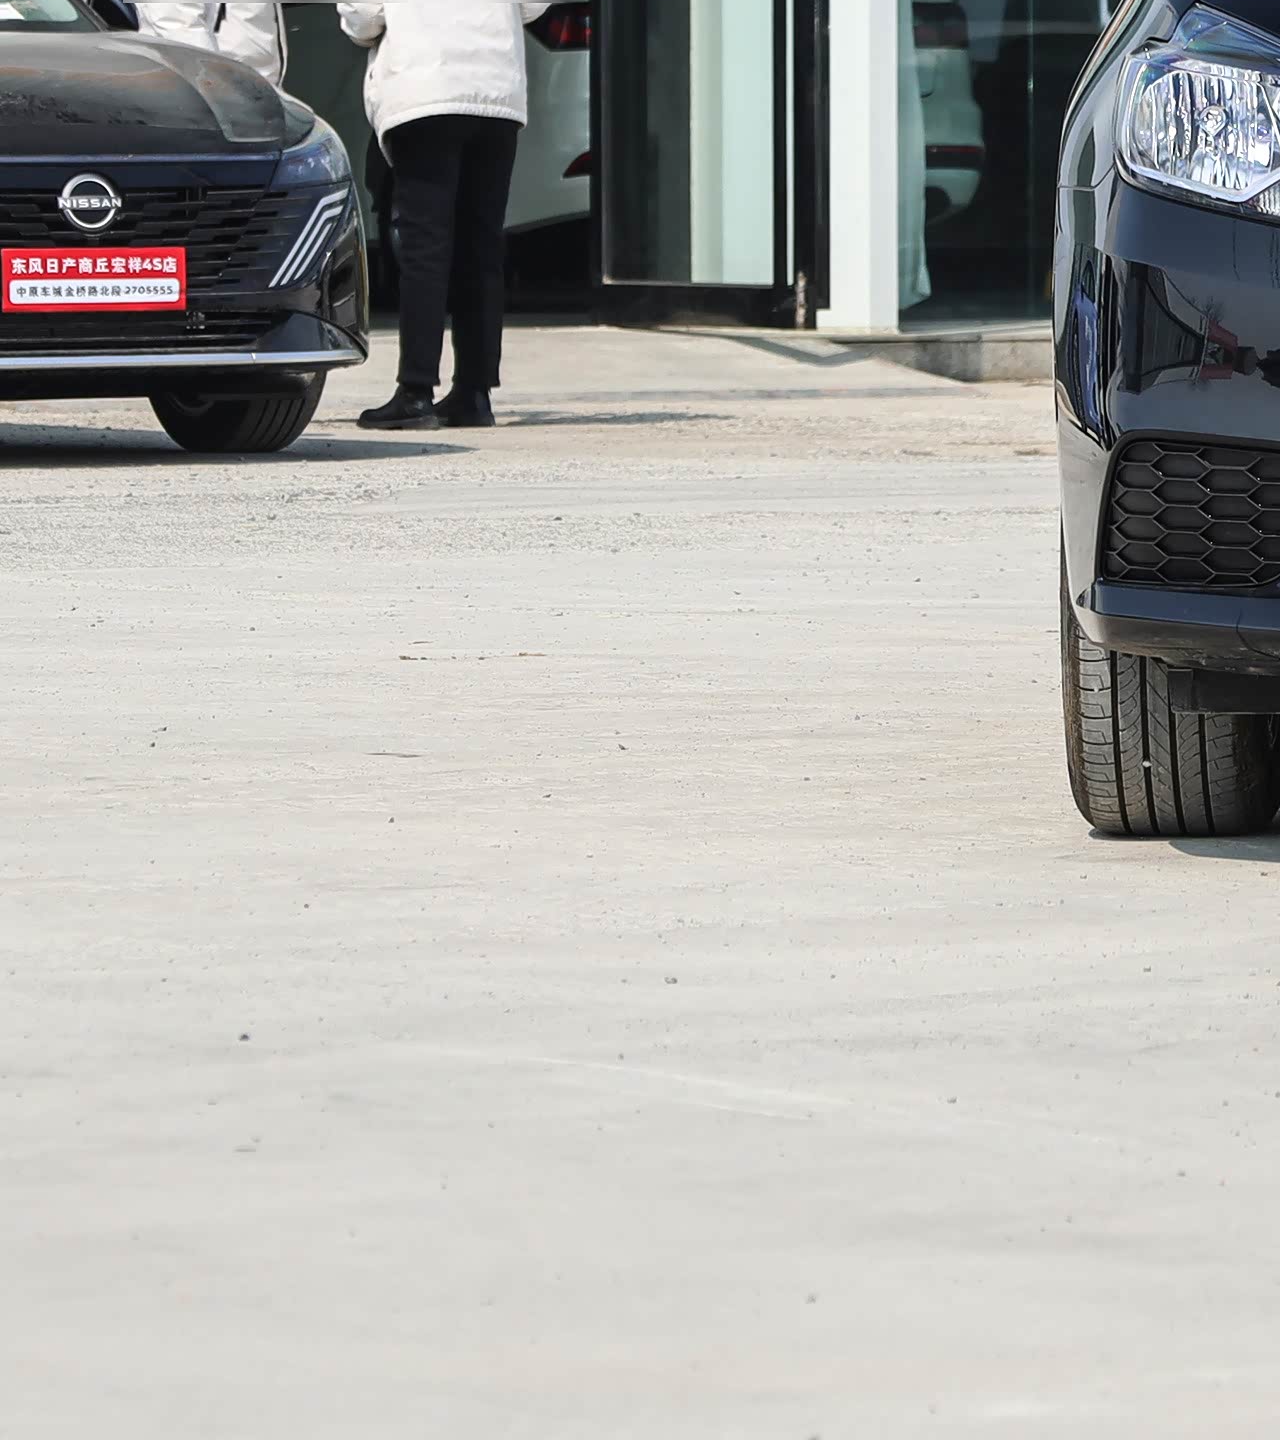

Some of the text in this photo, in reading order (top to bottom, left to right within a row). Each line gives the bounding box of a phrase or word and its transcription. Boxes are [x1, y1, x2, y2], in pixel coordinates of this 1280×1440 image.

[58, 197, 122, 209] NISSAN
[11, 256, 178, 274] 东风日产商丘宏祥4S店
